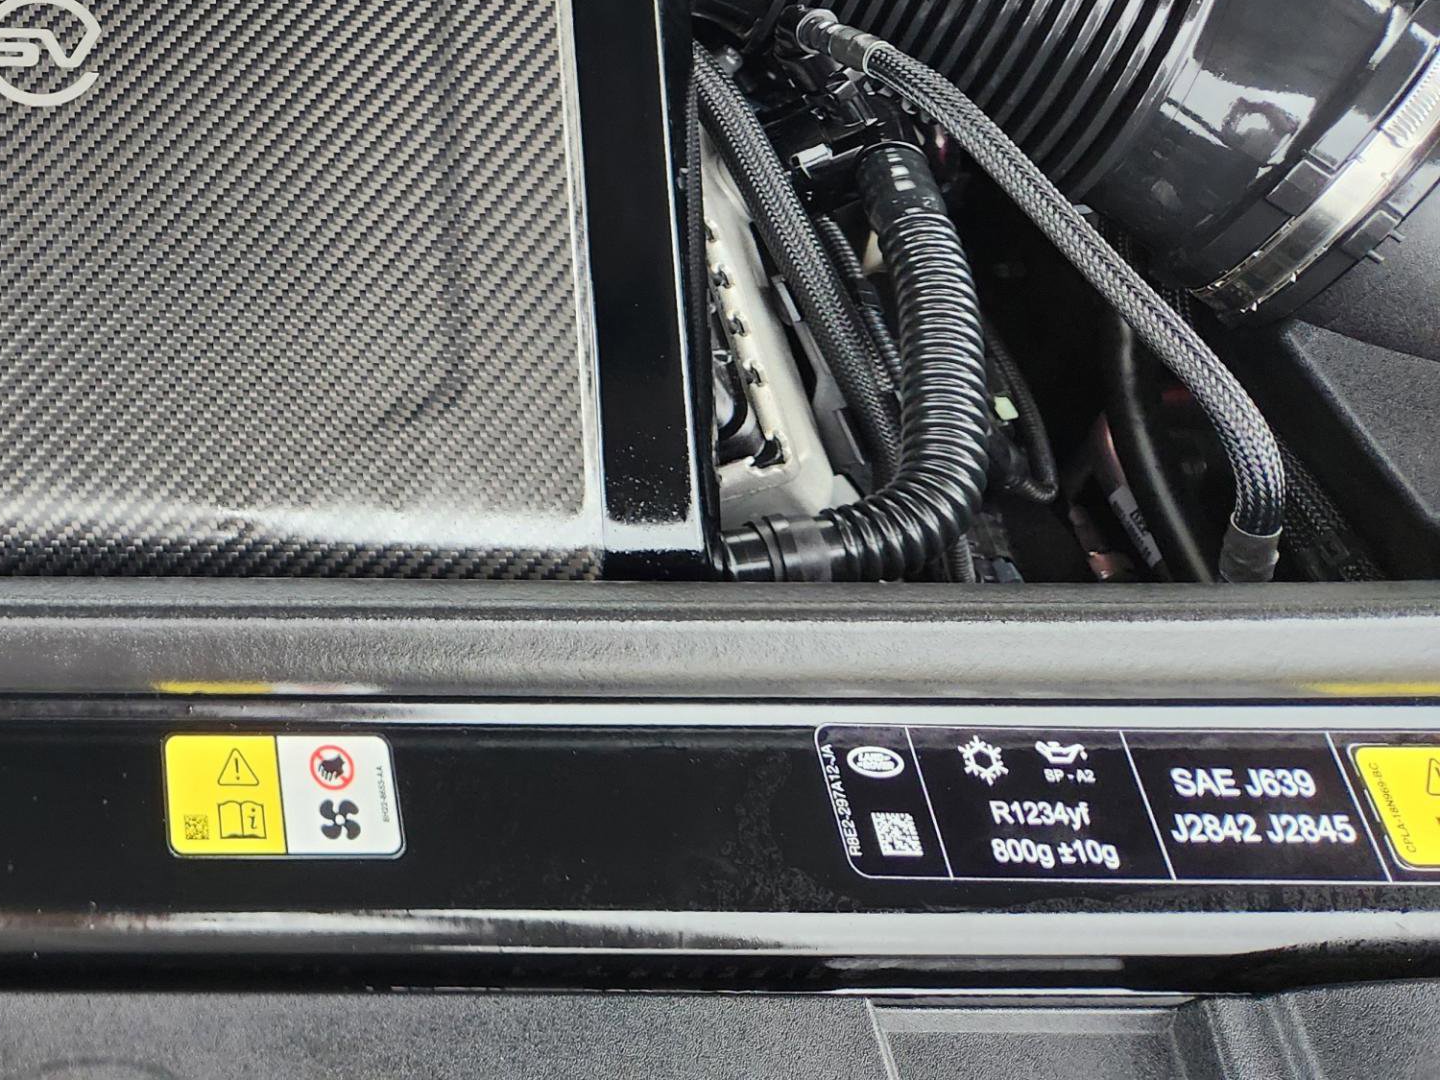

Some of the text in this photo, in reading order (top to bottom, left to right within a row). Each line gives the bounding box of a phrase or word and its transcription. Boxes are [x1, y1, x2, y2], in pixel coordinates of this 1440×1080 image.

[1170, 767, 1317, 799] SAE J639
[989, 800, 1091, 831] R1234yf
[1170, 813, 1358, 844] J2842 J2845
[991, 838, 1121, 870] 800g ±10g
